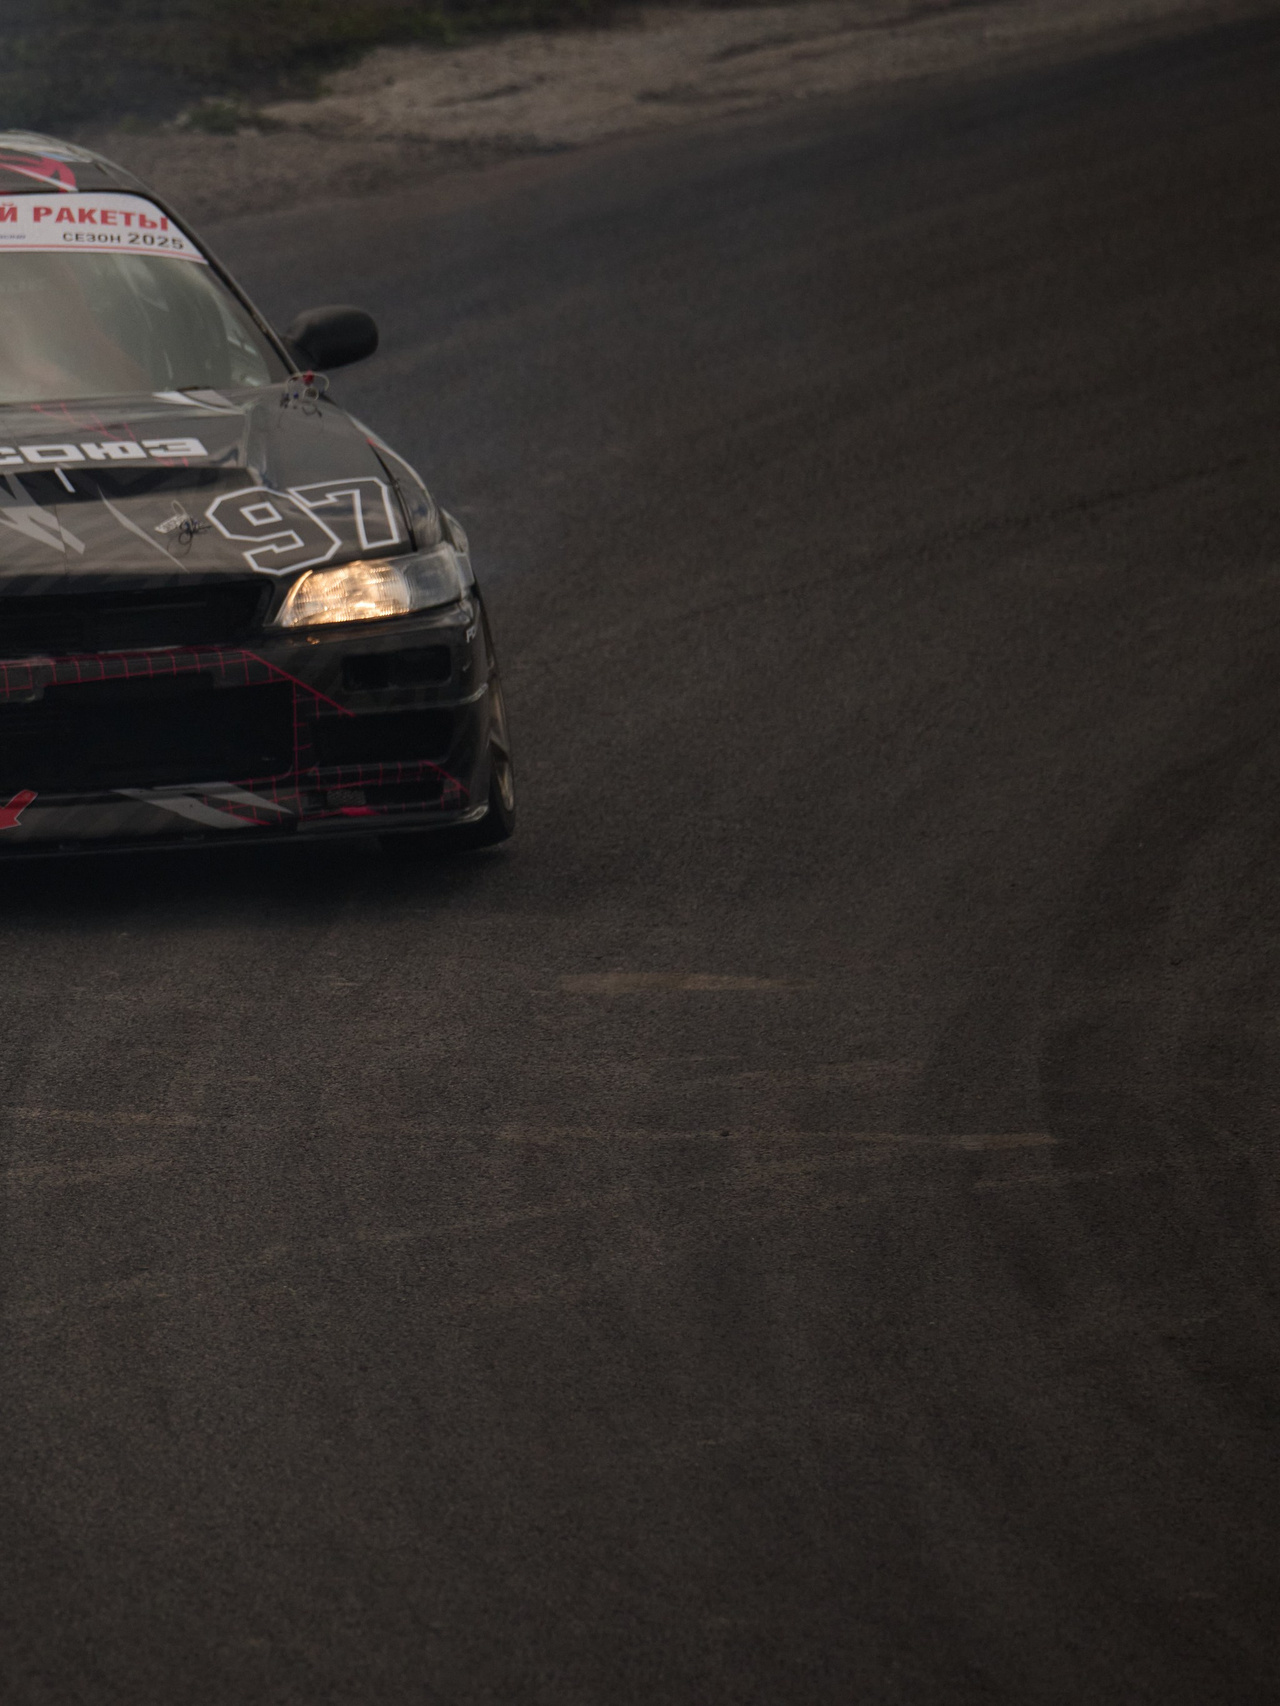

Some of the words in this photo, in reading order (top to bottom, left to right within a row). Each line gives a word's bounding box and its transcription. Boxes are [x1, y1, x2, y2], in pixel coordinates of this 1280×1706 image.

[33, 206, 169, 231] РАКЕТЫ
[62, 231, 121, 244] СЕЗОН
[127, 232, 184, 250] 2025
[205, 476, 401, 577] 97
